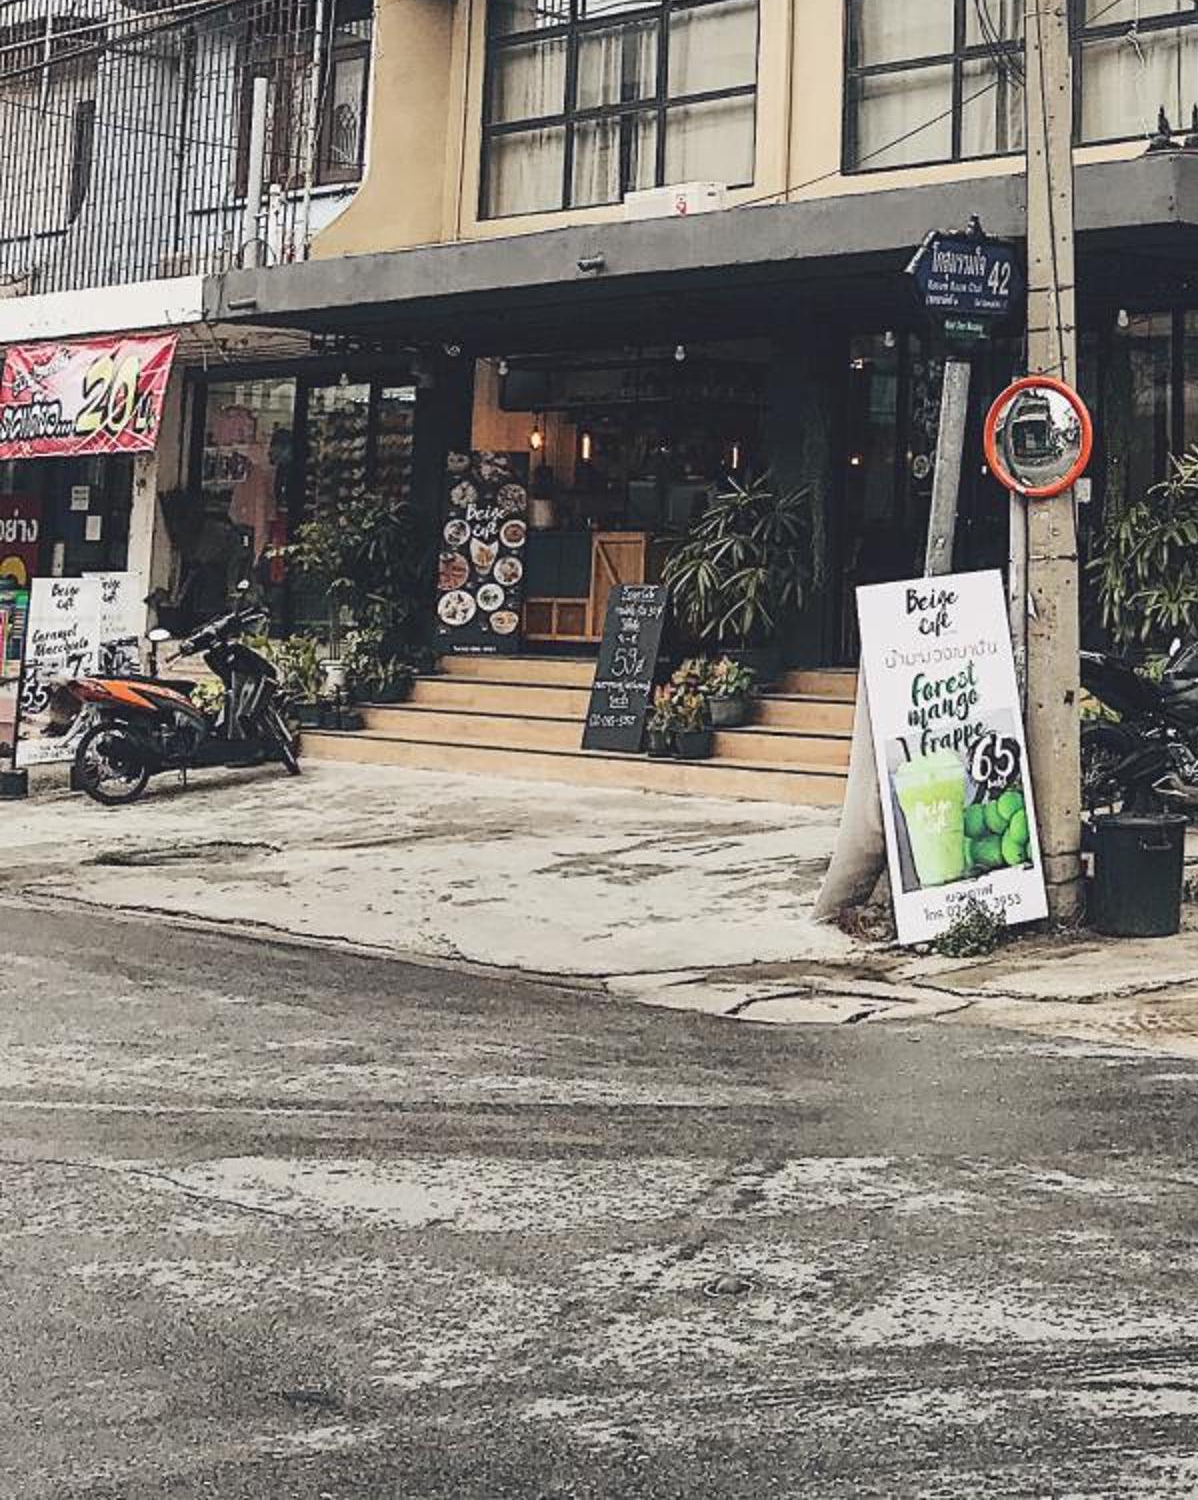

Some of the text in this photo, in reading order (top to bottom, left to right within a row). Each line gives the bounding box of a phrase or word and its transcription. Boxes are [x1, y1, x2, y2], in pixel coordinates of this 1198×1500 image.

[987, 260, 1011, 295] 42
[75, 355, 140, 436] 20
[465, 503, 505, 522] Beige
[906, 588, 958, 614] Beige
[23, 684, 49, 707] 55
[971, 733, 1015, 782] 65
